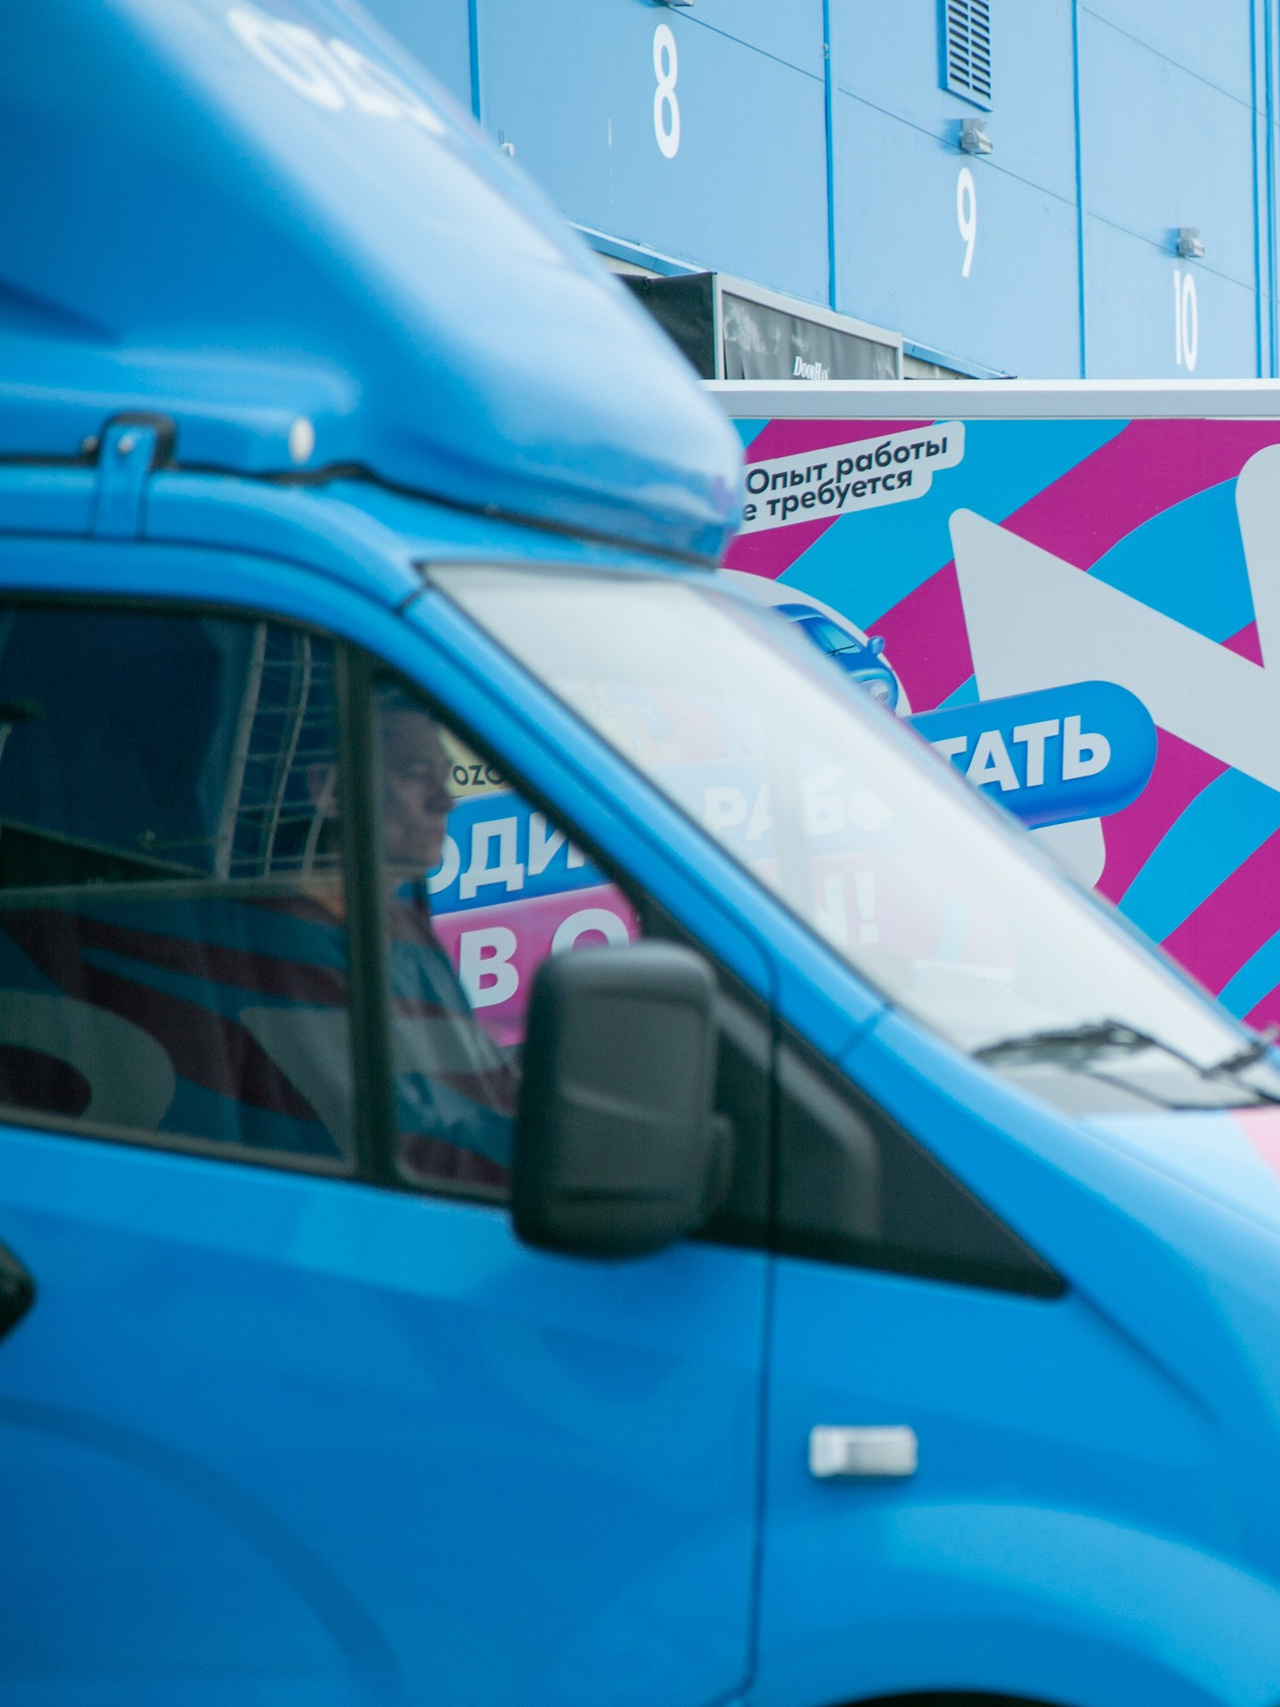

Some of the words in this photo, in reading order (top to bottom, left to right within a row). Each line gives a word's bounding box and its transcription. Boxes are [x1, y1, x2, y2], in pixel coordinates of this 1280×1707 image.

[653, 23, 681, 159] 8
[957, 167, 977, 278] 9
[1174, 268, 1198, 372] 10
[743, 503, 757, 521] е
[766, 470, 913, 521] требуется
[746, 463, 827, 494] Опыт
[836, 437, 947, 483] работы
